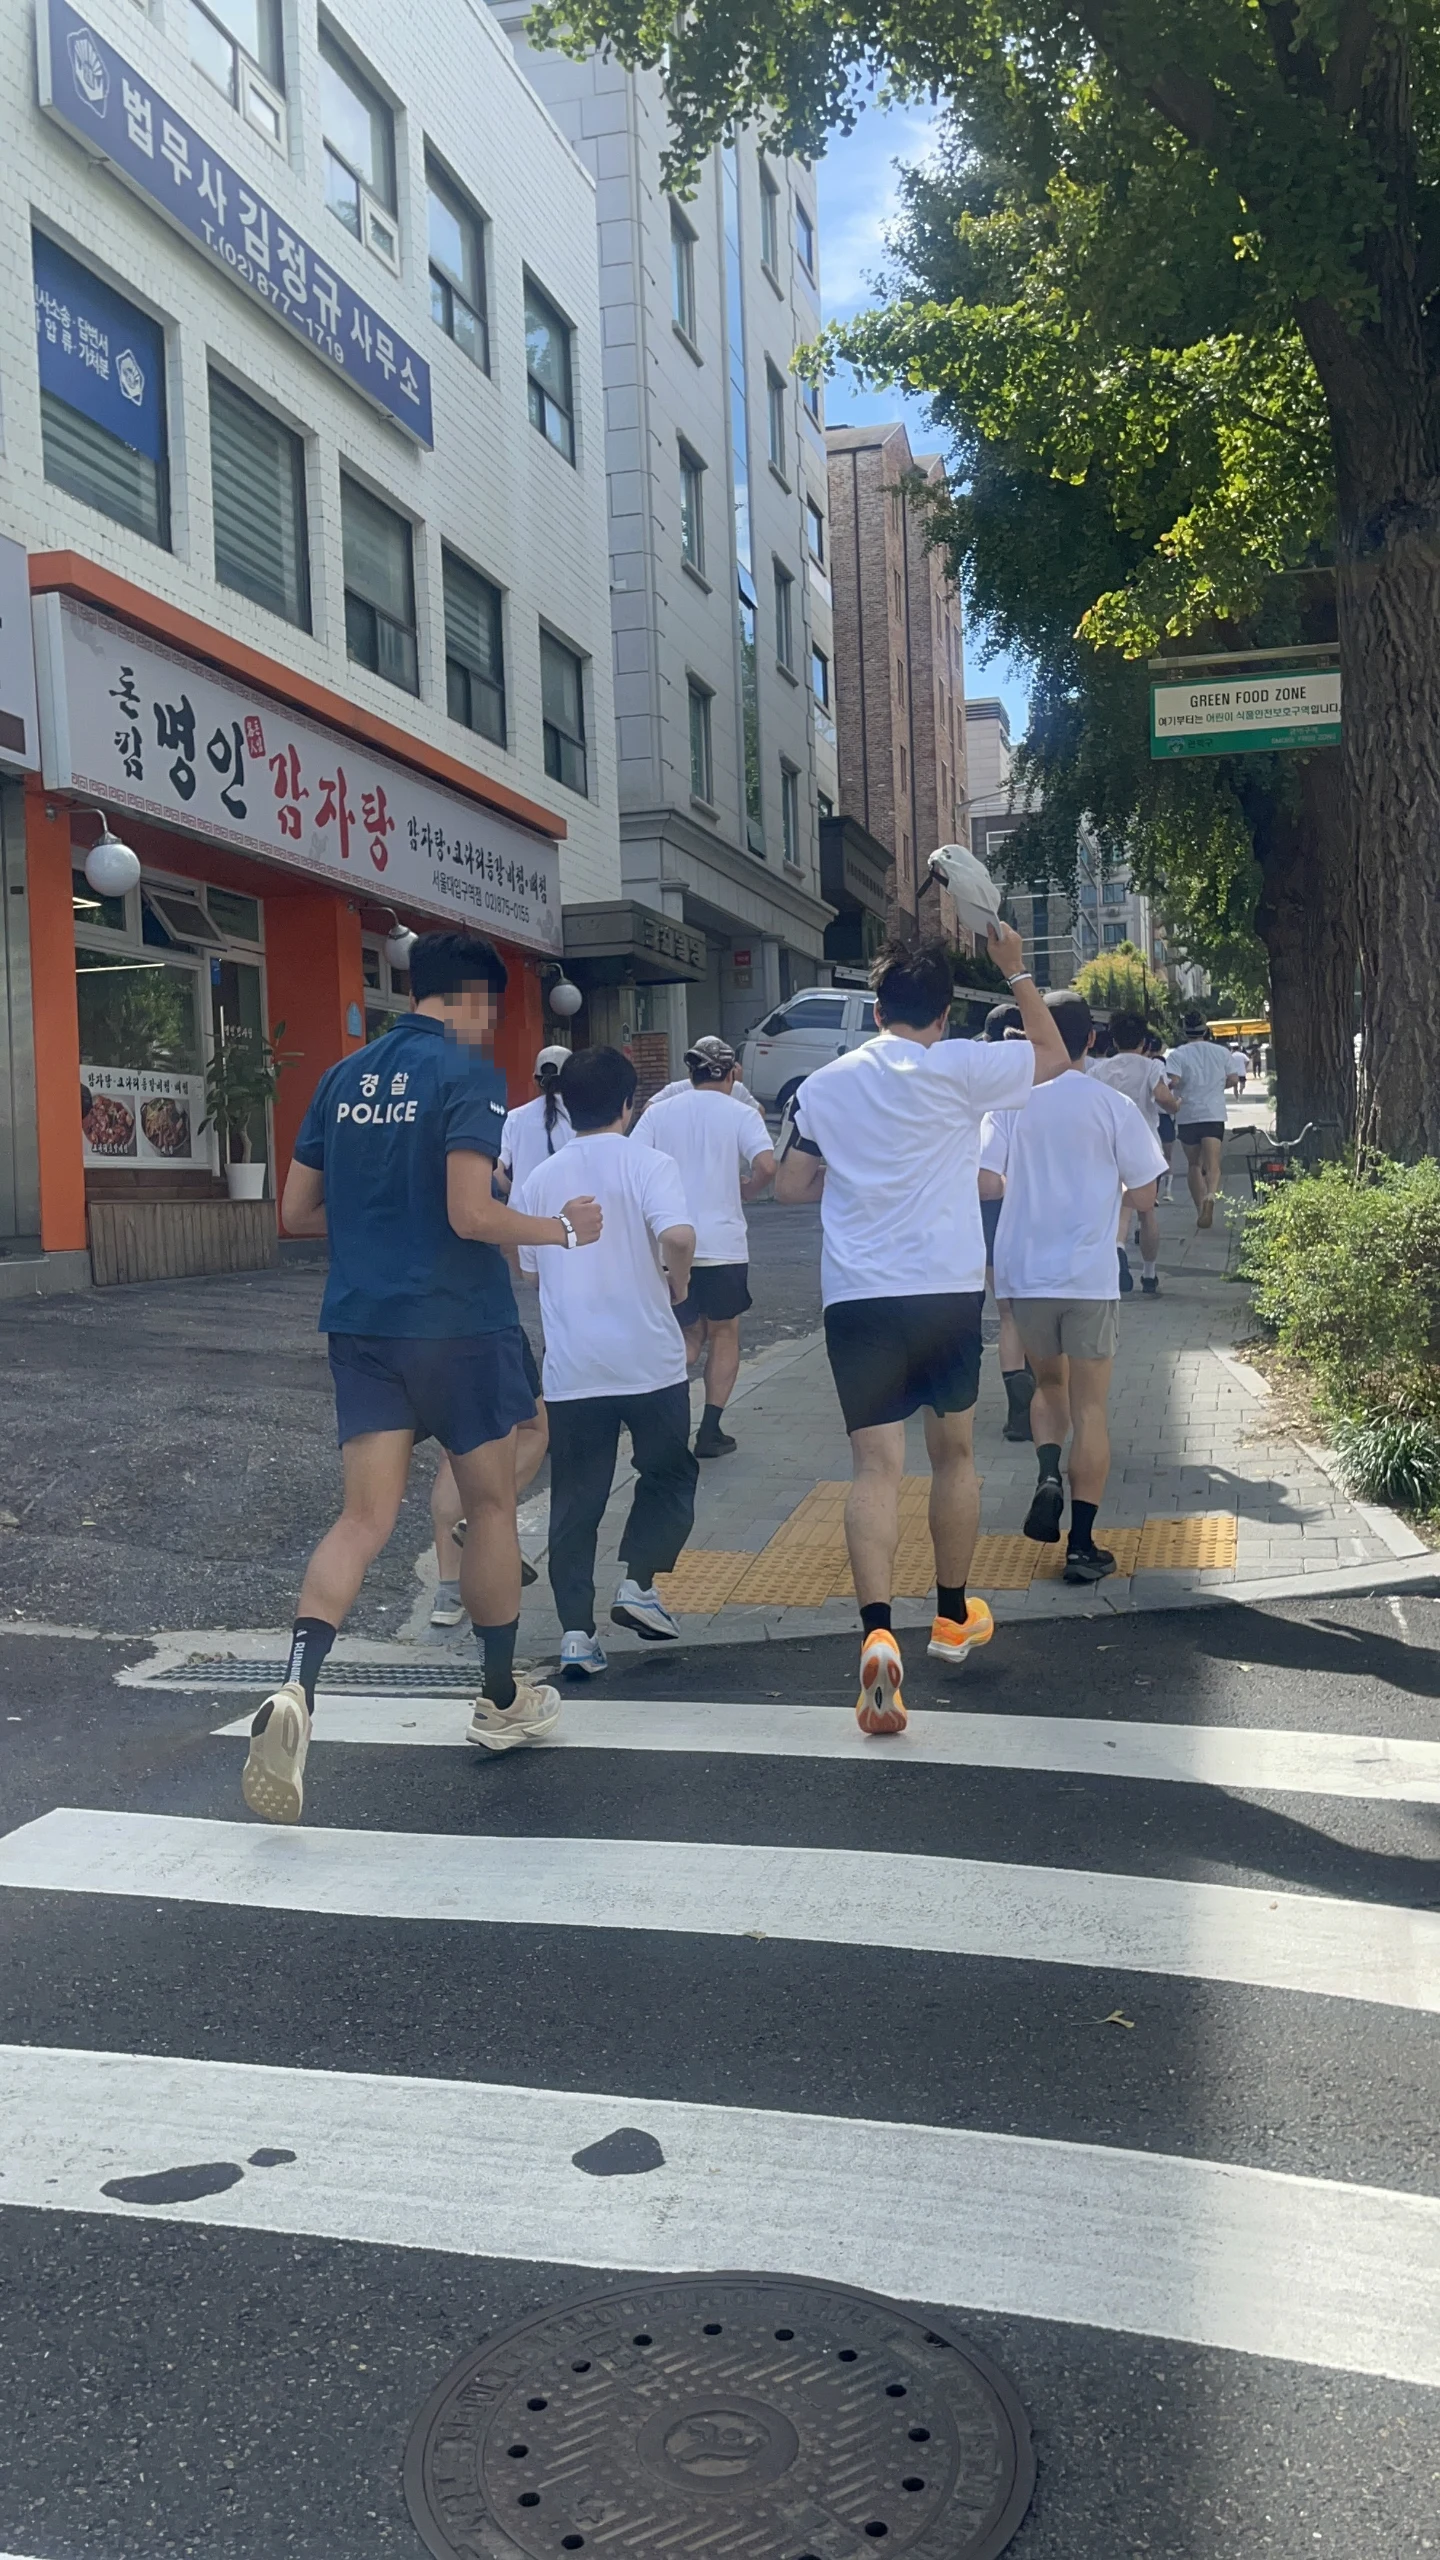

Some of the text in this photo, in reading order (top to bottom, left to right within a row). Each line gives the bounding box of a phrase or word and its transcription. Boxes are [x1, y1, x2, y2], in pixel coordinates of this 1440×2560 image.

[121, 77, 421, 405] 법무사 김정규 사무소
[1189, 686, 1307, 708] GREEN FOOD ZONE
[1158, 713, 1204, 727] 여기부터는
[1206, 711, 1234, 723] 어린이
[268, 743, 396, 872] 감자탕
[432, 869, 482, 907] 서울대입구역점
[336, 1100, 418, 1124] POLICE
